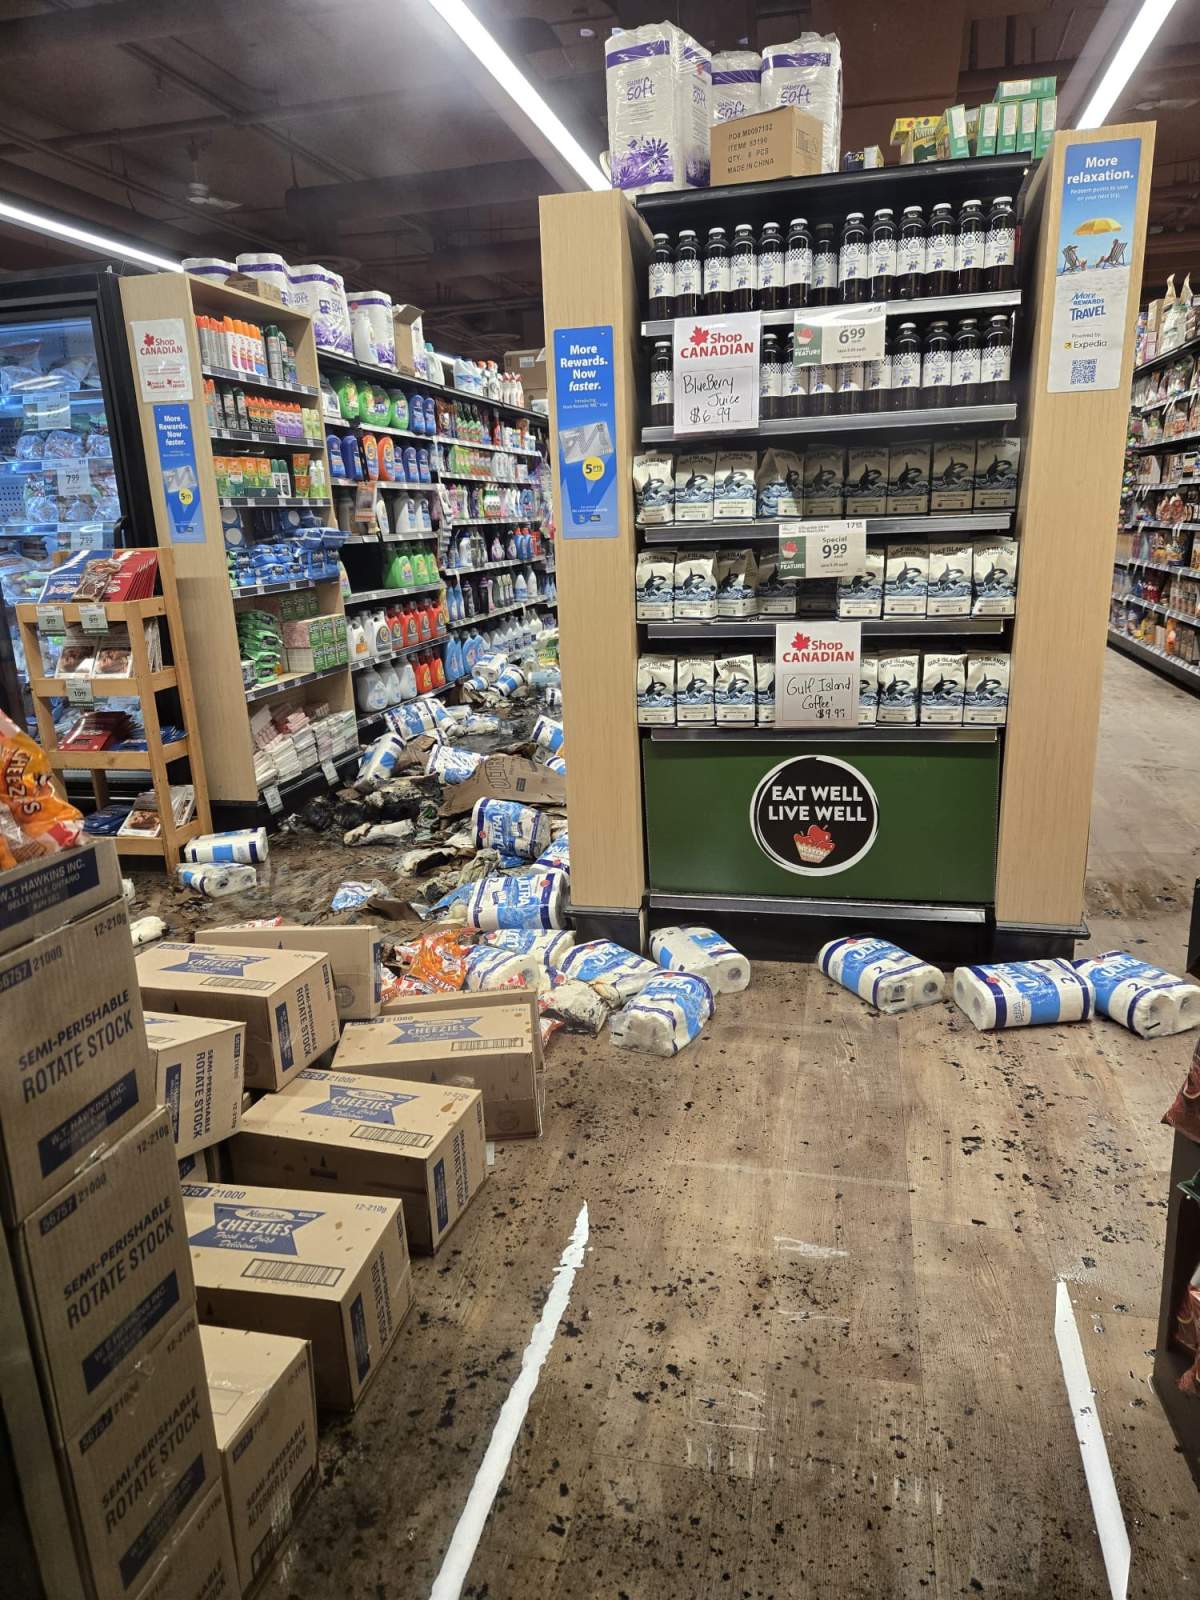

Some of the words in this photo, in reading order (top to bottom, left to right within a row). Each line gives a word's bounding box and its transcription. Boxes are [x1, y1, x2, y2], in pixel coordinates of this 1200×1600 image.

[627, 76, 656, 101] soft
[780, 83, 811, 105] soft
[727, 163, 745, 174] MADE
[753, 158, 774, 168] CHINA
[1085, 157, 1119, 168] More
[1067, 169, 1134, 185] relaxation.
[1073, 298, 1105, 306] REWARDS
[1069, 305, 1107, 321] TRAVEL
[155, 337, 176, 346] Shop
[710, 332, 743, 345] Shop
[1073, 340, 1108, 349] Expedia
[140, 345, 183, 356] CANADIAN
[569, 344, 598, 355] More
[680, 342, 754, 359] CANADIAN
[560, 355, 609, 368] Rewards.
[572, 368, 597, 379] Now
[568, 381, 602, 392] faster.
[707, 393, 740, 407] Juice
[585, 464, 593, 474] 5
[822, 536, 848, 544] Special
[811, 640, 844, 652] Shop
[782, 651, 855, 663] CANADIAN
[786, 676, 816, 696] Gulf
[816, 676, 851, 693] Island
[772, 786, 807, 801] EAT
[811, 786, 863, 802] WELL
[768, 805, 810, 821] LIVE
[815, 806, 867, 822] WELL
[32, 945, 63, 972] 21000
[1101, 957, 1146, 977] ULTRA
[295, 987, 307, 1025] ROTATE
[301, 1024, 312, 1058] STOCK
[407, 1025, 467, 1036] CHEEZIES
[19, 990, 130, 1072] SEMI-PERISHABLE
[22, 1043, 85, 1104] ROTATE
[87, 1008, 134, 1059] STOCK
[195, 1051, 206, 1098] ROTATE
[331, 1095, 393, 1112] CHEEZIES
[193, 1098, 204, 1140] STOCK
[210, 1188, 247, 1200] 21000
[354, 1202, 388, 1214] 12-210g
[216, 1218, 293, 1237] CHEEZIES
[63, 1197, 172, 1299] SEMI-PERISHABLE
[67, 1258, 128, 1330] ROTATE
[129, 1215, 175, 1272] STOCK
[102, 1386, 198, 1508] SEMI-PERISHABLE
[104, 1457, 160, 1534] ROTATE
[159, 1402, 201, 1463] STOCK
